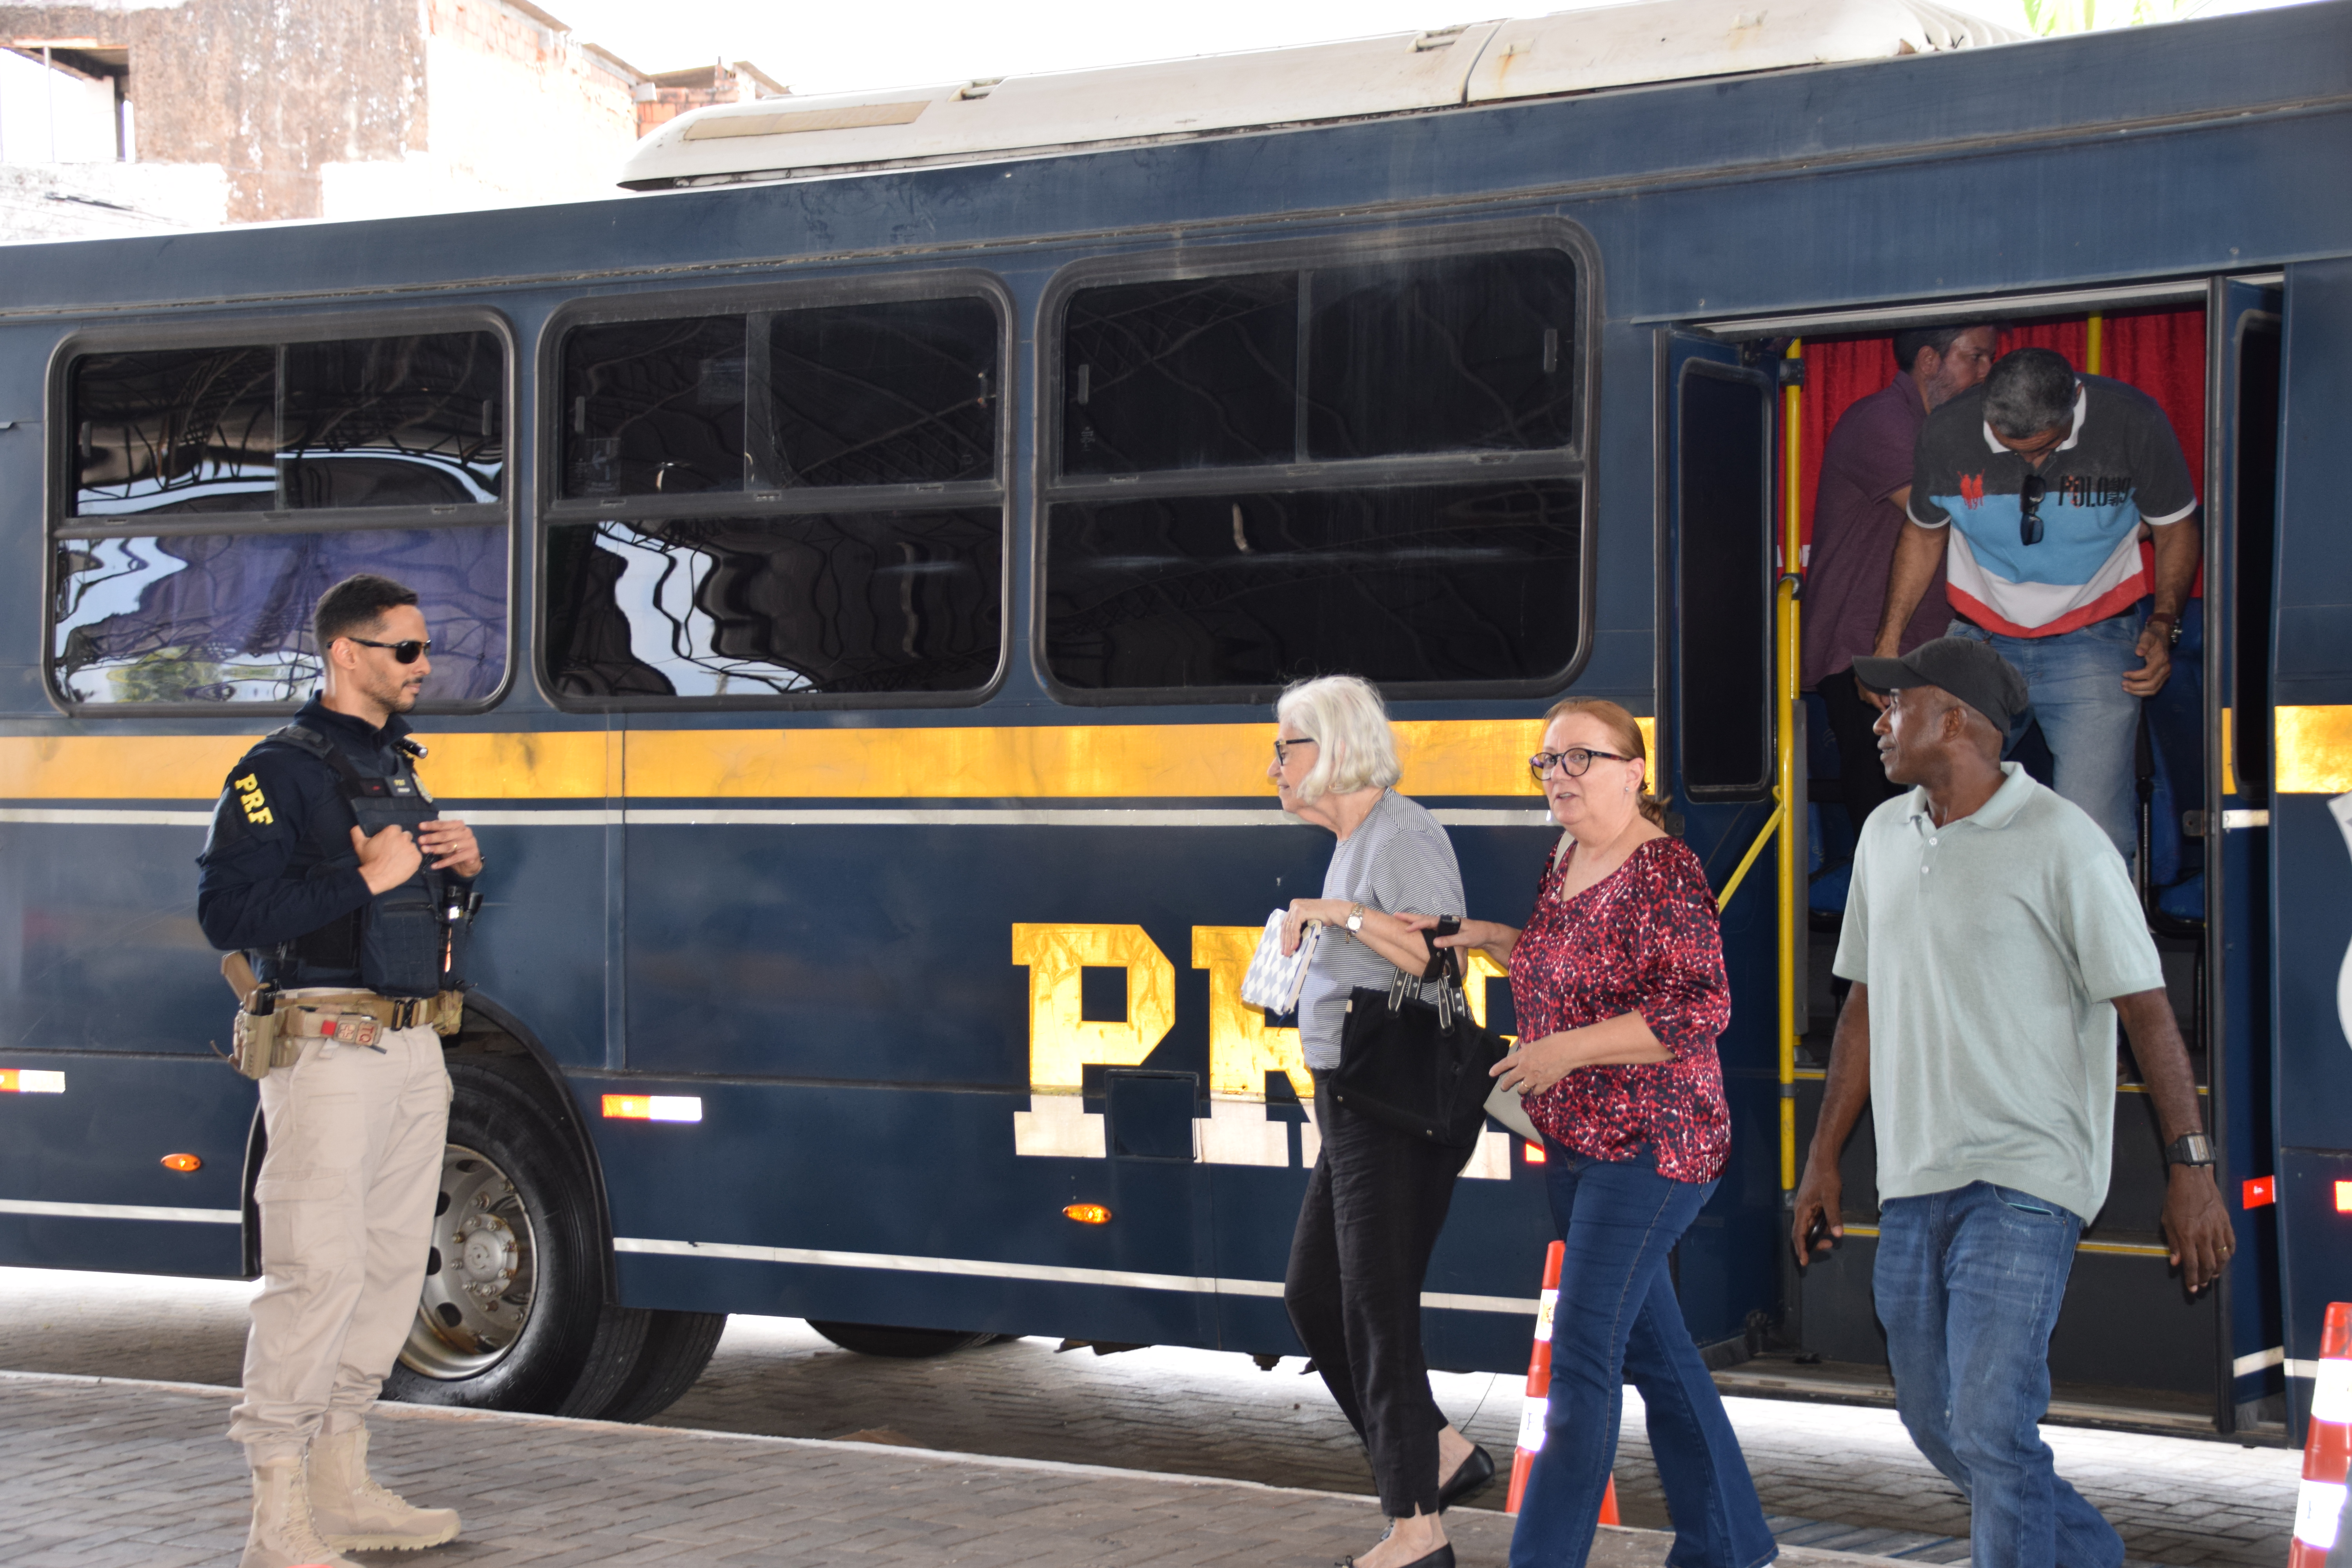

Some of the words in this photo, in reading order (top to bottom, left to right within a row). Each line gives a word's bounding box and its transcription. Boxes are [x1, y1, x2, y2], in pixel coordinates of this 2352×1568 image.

[2058, 475, 2107, 507] POLO
[235, 773, 274, 825] PRF
[359, 1025, 375, 1043] TQ
